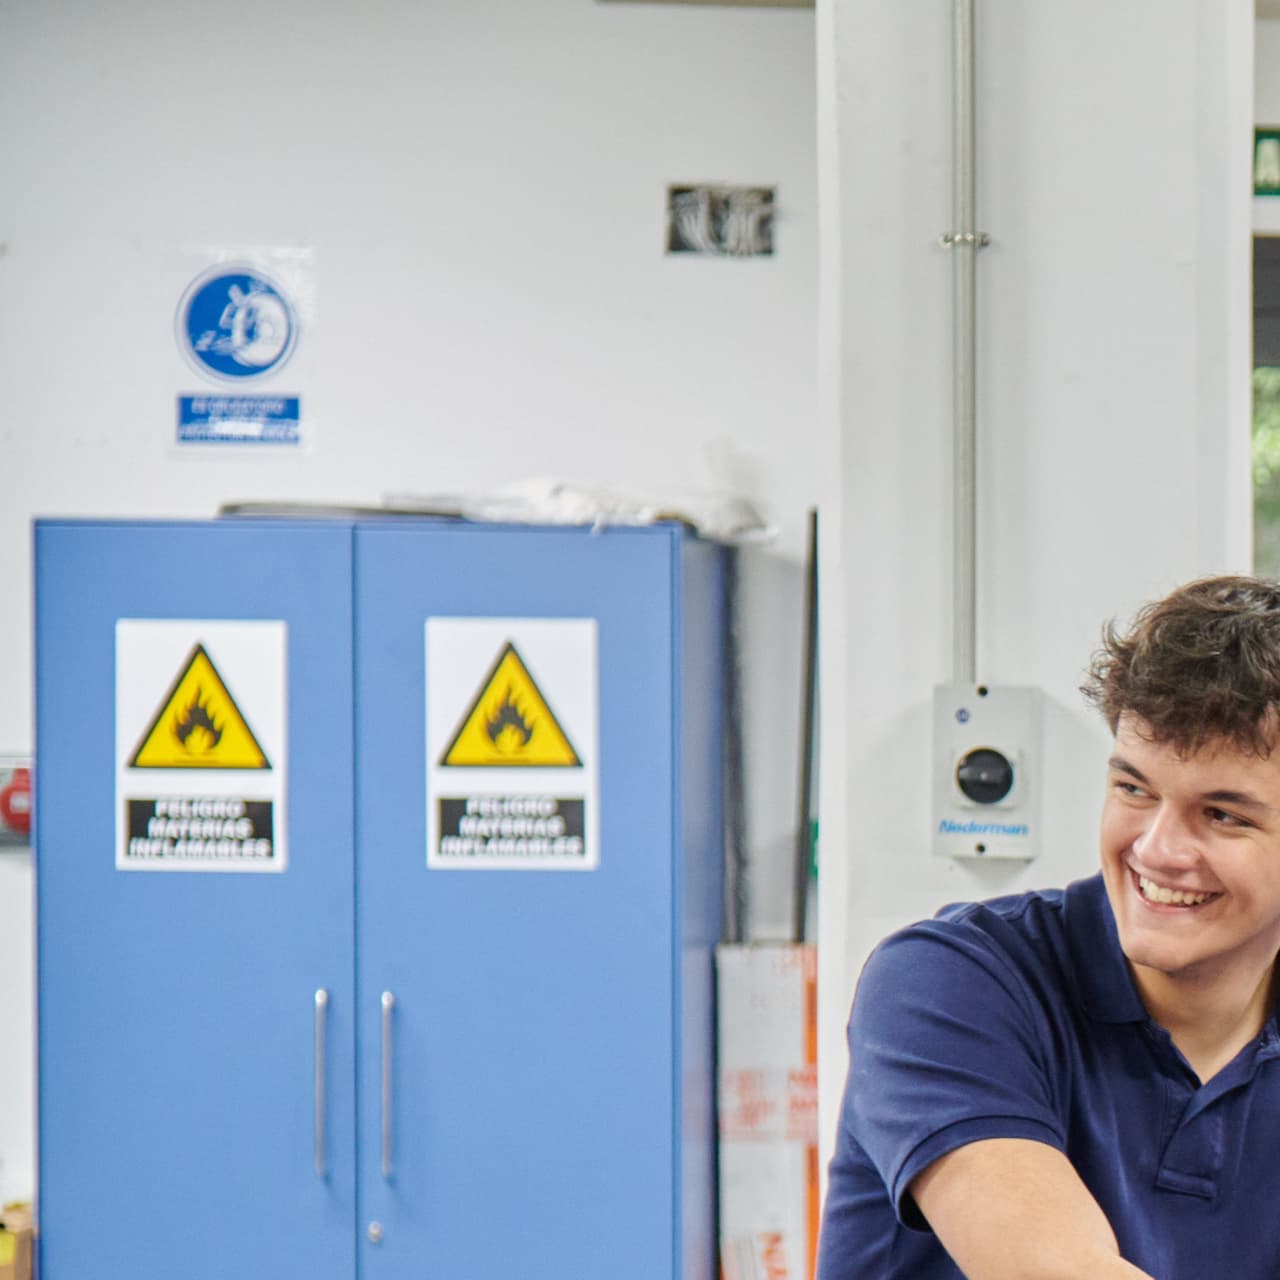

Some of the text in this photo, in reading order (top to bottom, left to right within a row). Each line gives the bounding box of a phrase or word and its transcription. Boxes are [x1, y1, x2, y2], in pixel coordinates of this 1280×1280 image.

[155, 799, 246, 819] PELIGRO
[466, 797, 559, 817] PELIGRO
[148, 817, 254, 839] MATERIAS
[459, 814, 565, 837] MATERIAS
[129, 837, 272, 857] INFLAMABLES
[441, 835, 583, 856] INFLAMABLES
